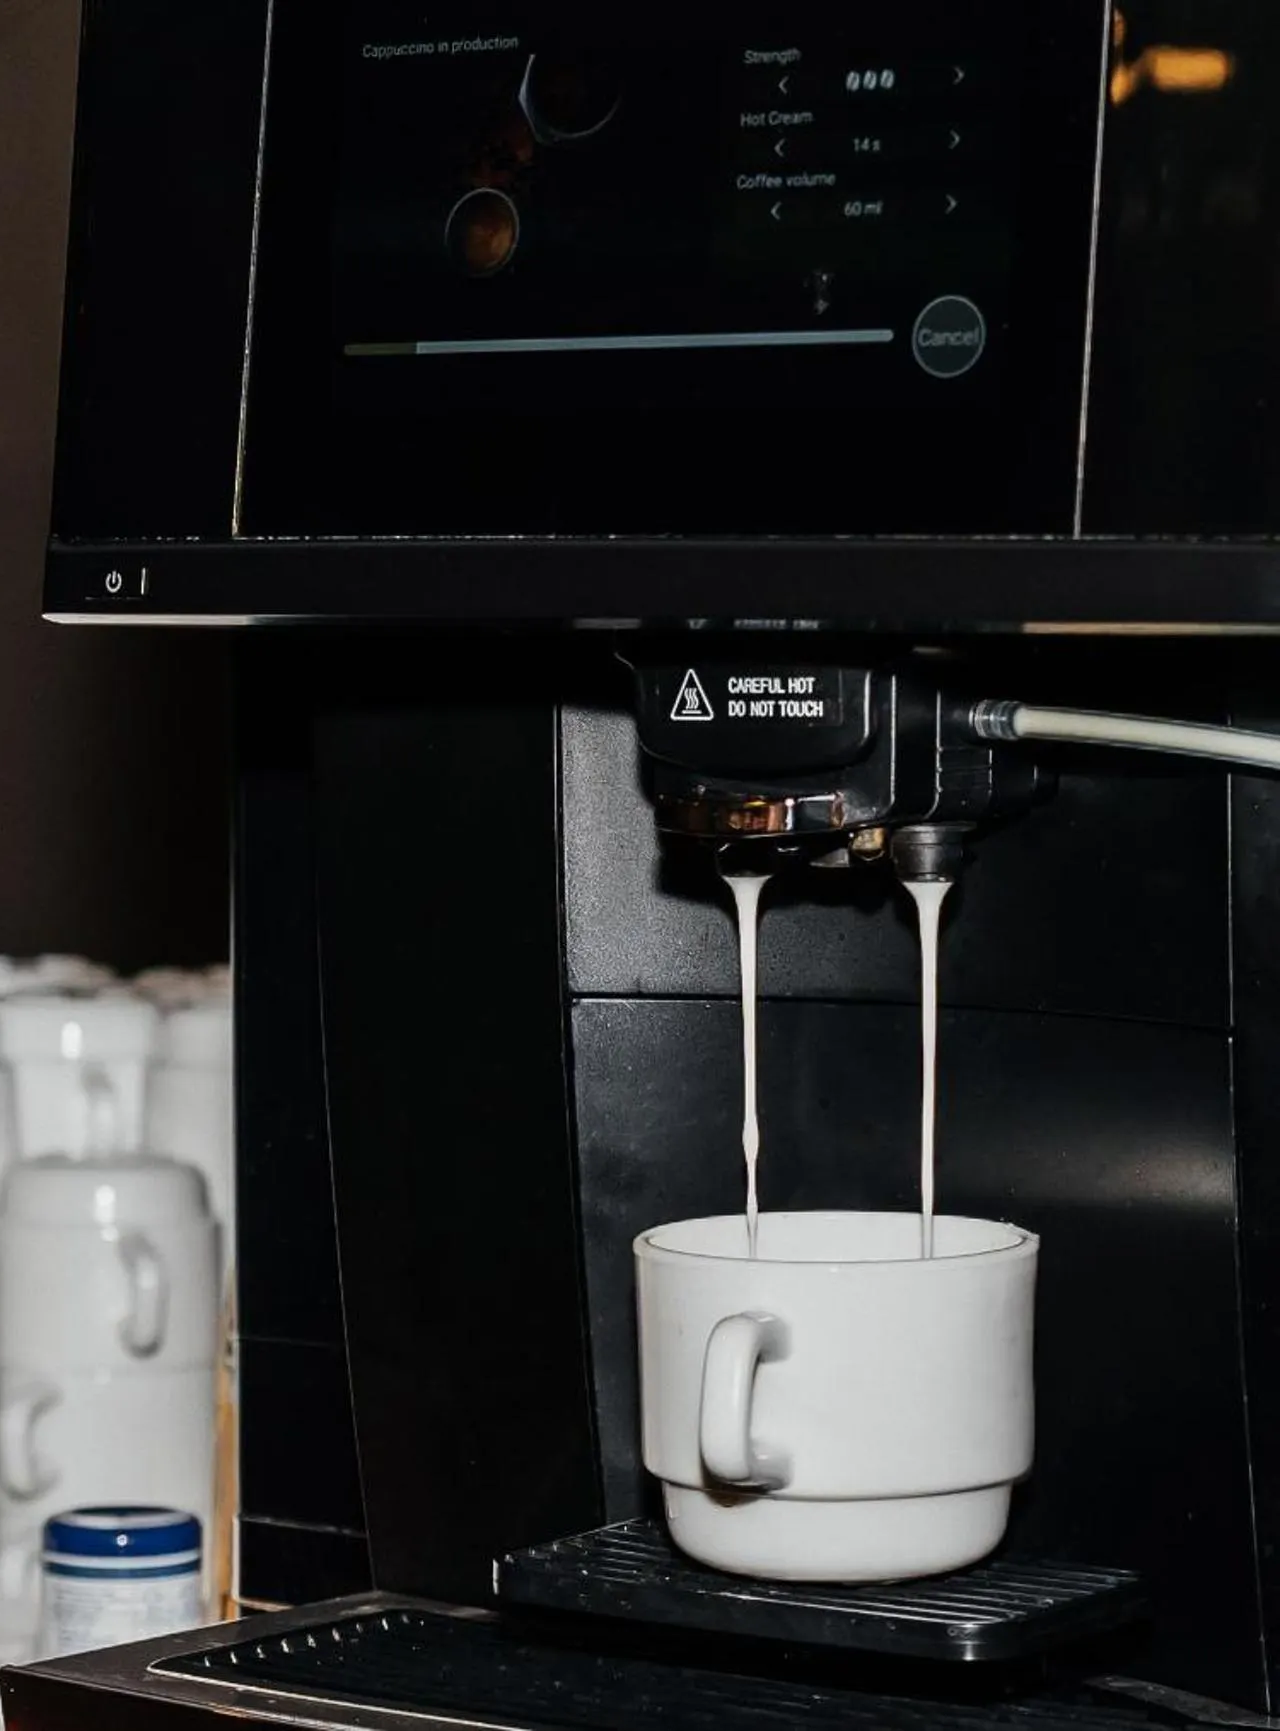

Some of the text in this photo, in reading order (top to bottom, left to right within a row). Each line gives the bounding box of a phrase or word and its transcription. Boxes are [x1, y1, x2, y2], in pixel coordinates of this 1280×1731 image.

[362, 34, 519, 60] Cappuccino in production
[744, 48, 802, 65] Strength
[740, 110, 813, 127] Hot Cream
[853, 138, 869, 152] 14
[737, 171, 836, 189] Coffee volume
[844, 200, 883, 216] 60 ml
[920, 328, 979, 347] Cancel
[728, 677, 815, 694] CAREFUL HOT
[728, 701, 824, 718] DO NOT TOUCH
